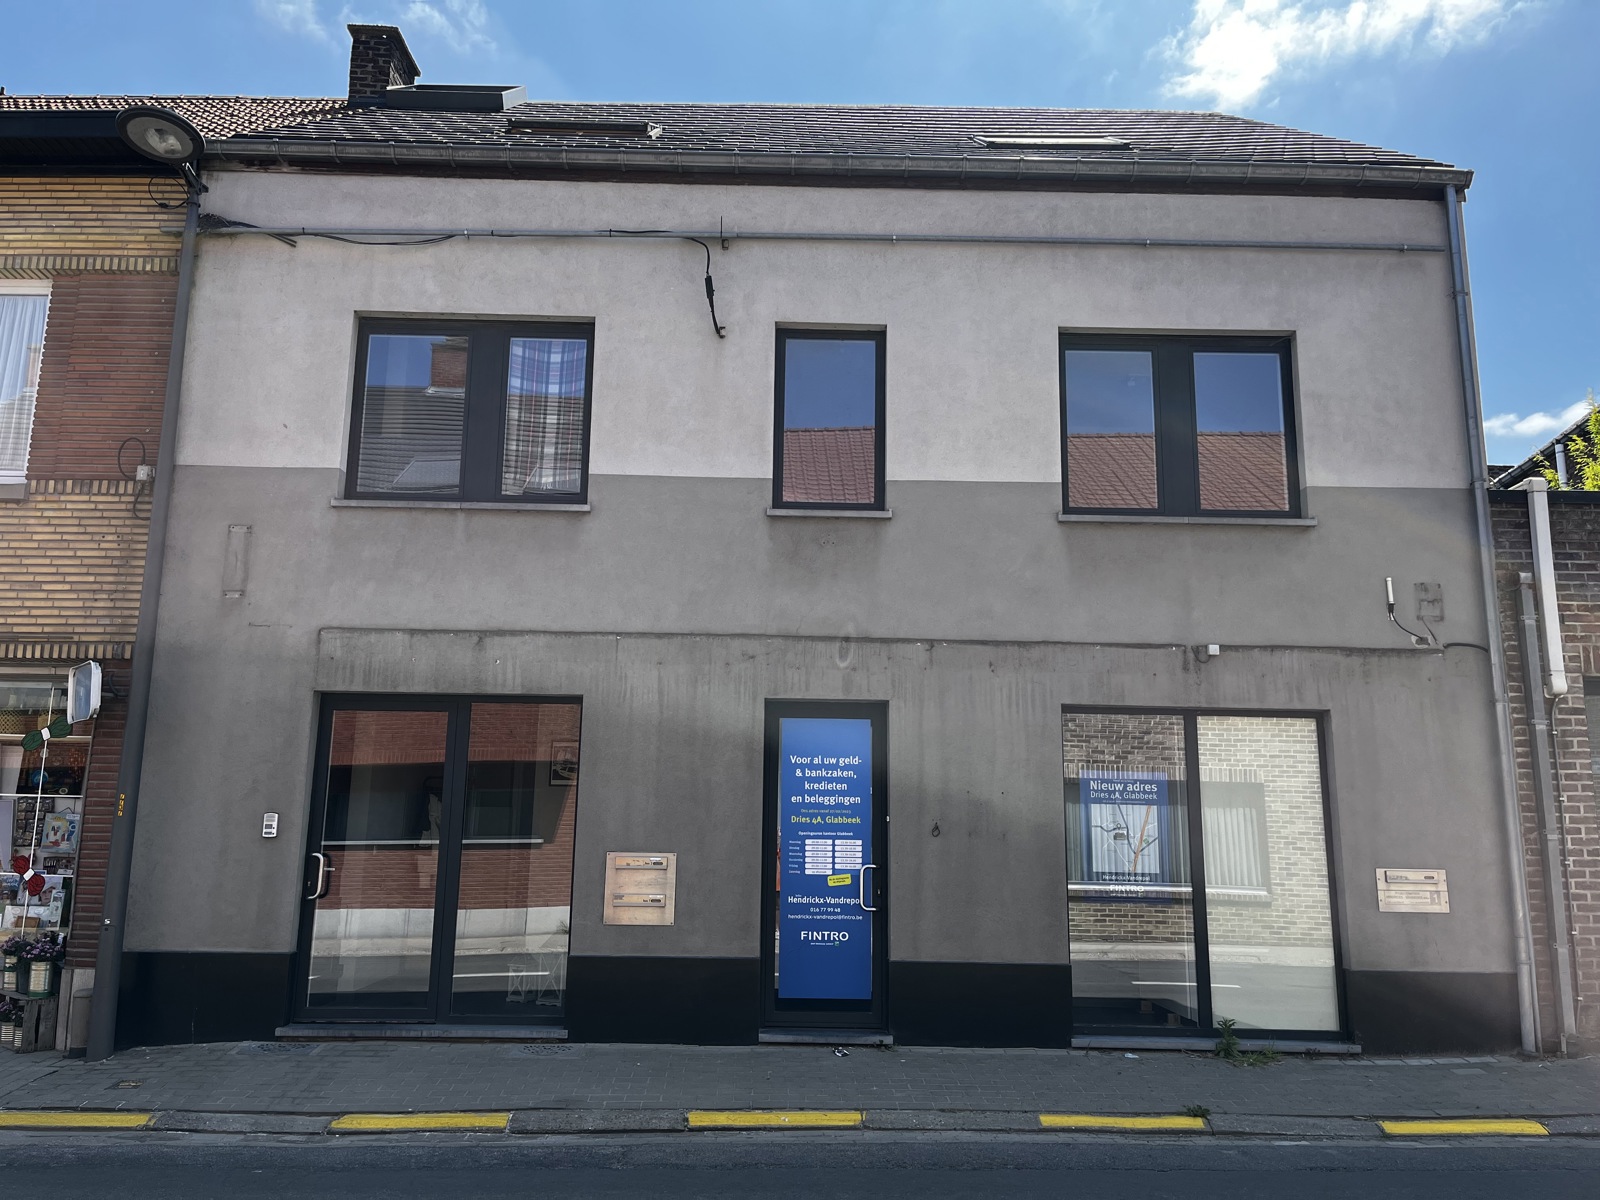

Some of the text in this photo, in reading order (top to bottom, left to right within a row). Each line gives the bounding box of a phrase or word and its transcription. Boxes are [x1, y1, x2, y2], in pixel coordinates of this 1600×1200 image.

[790, 755, 811, 764] Voor
[813, 755, 822, 764] al
[838, 755, 862, 766] geld-
[795, 768, 857, 779] & bankzaken,
[804, 781, 848, 791] kredieten
[1090, 780, 1158, 792] Nieuw adres
[791, 794, 861, 805] en beleggingen
[1090, 791, 1158, 800] Dries 4A, Glabbeek
[791, 815, 861, 824] Dries 4A, Glabbeek
[787, 896, 860, 906] Hendrickx-Vandrepo
[800, 931, 849, 941] FINTRO
